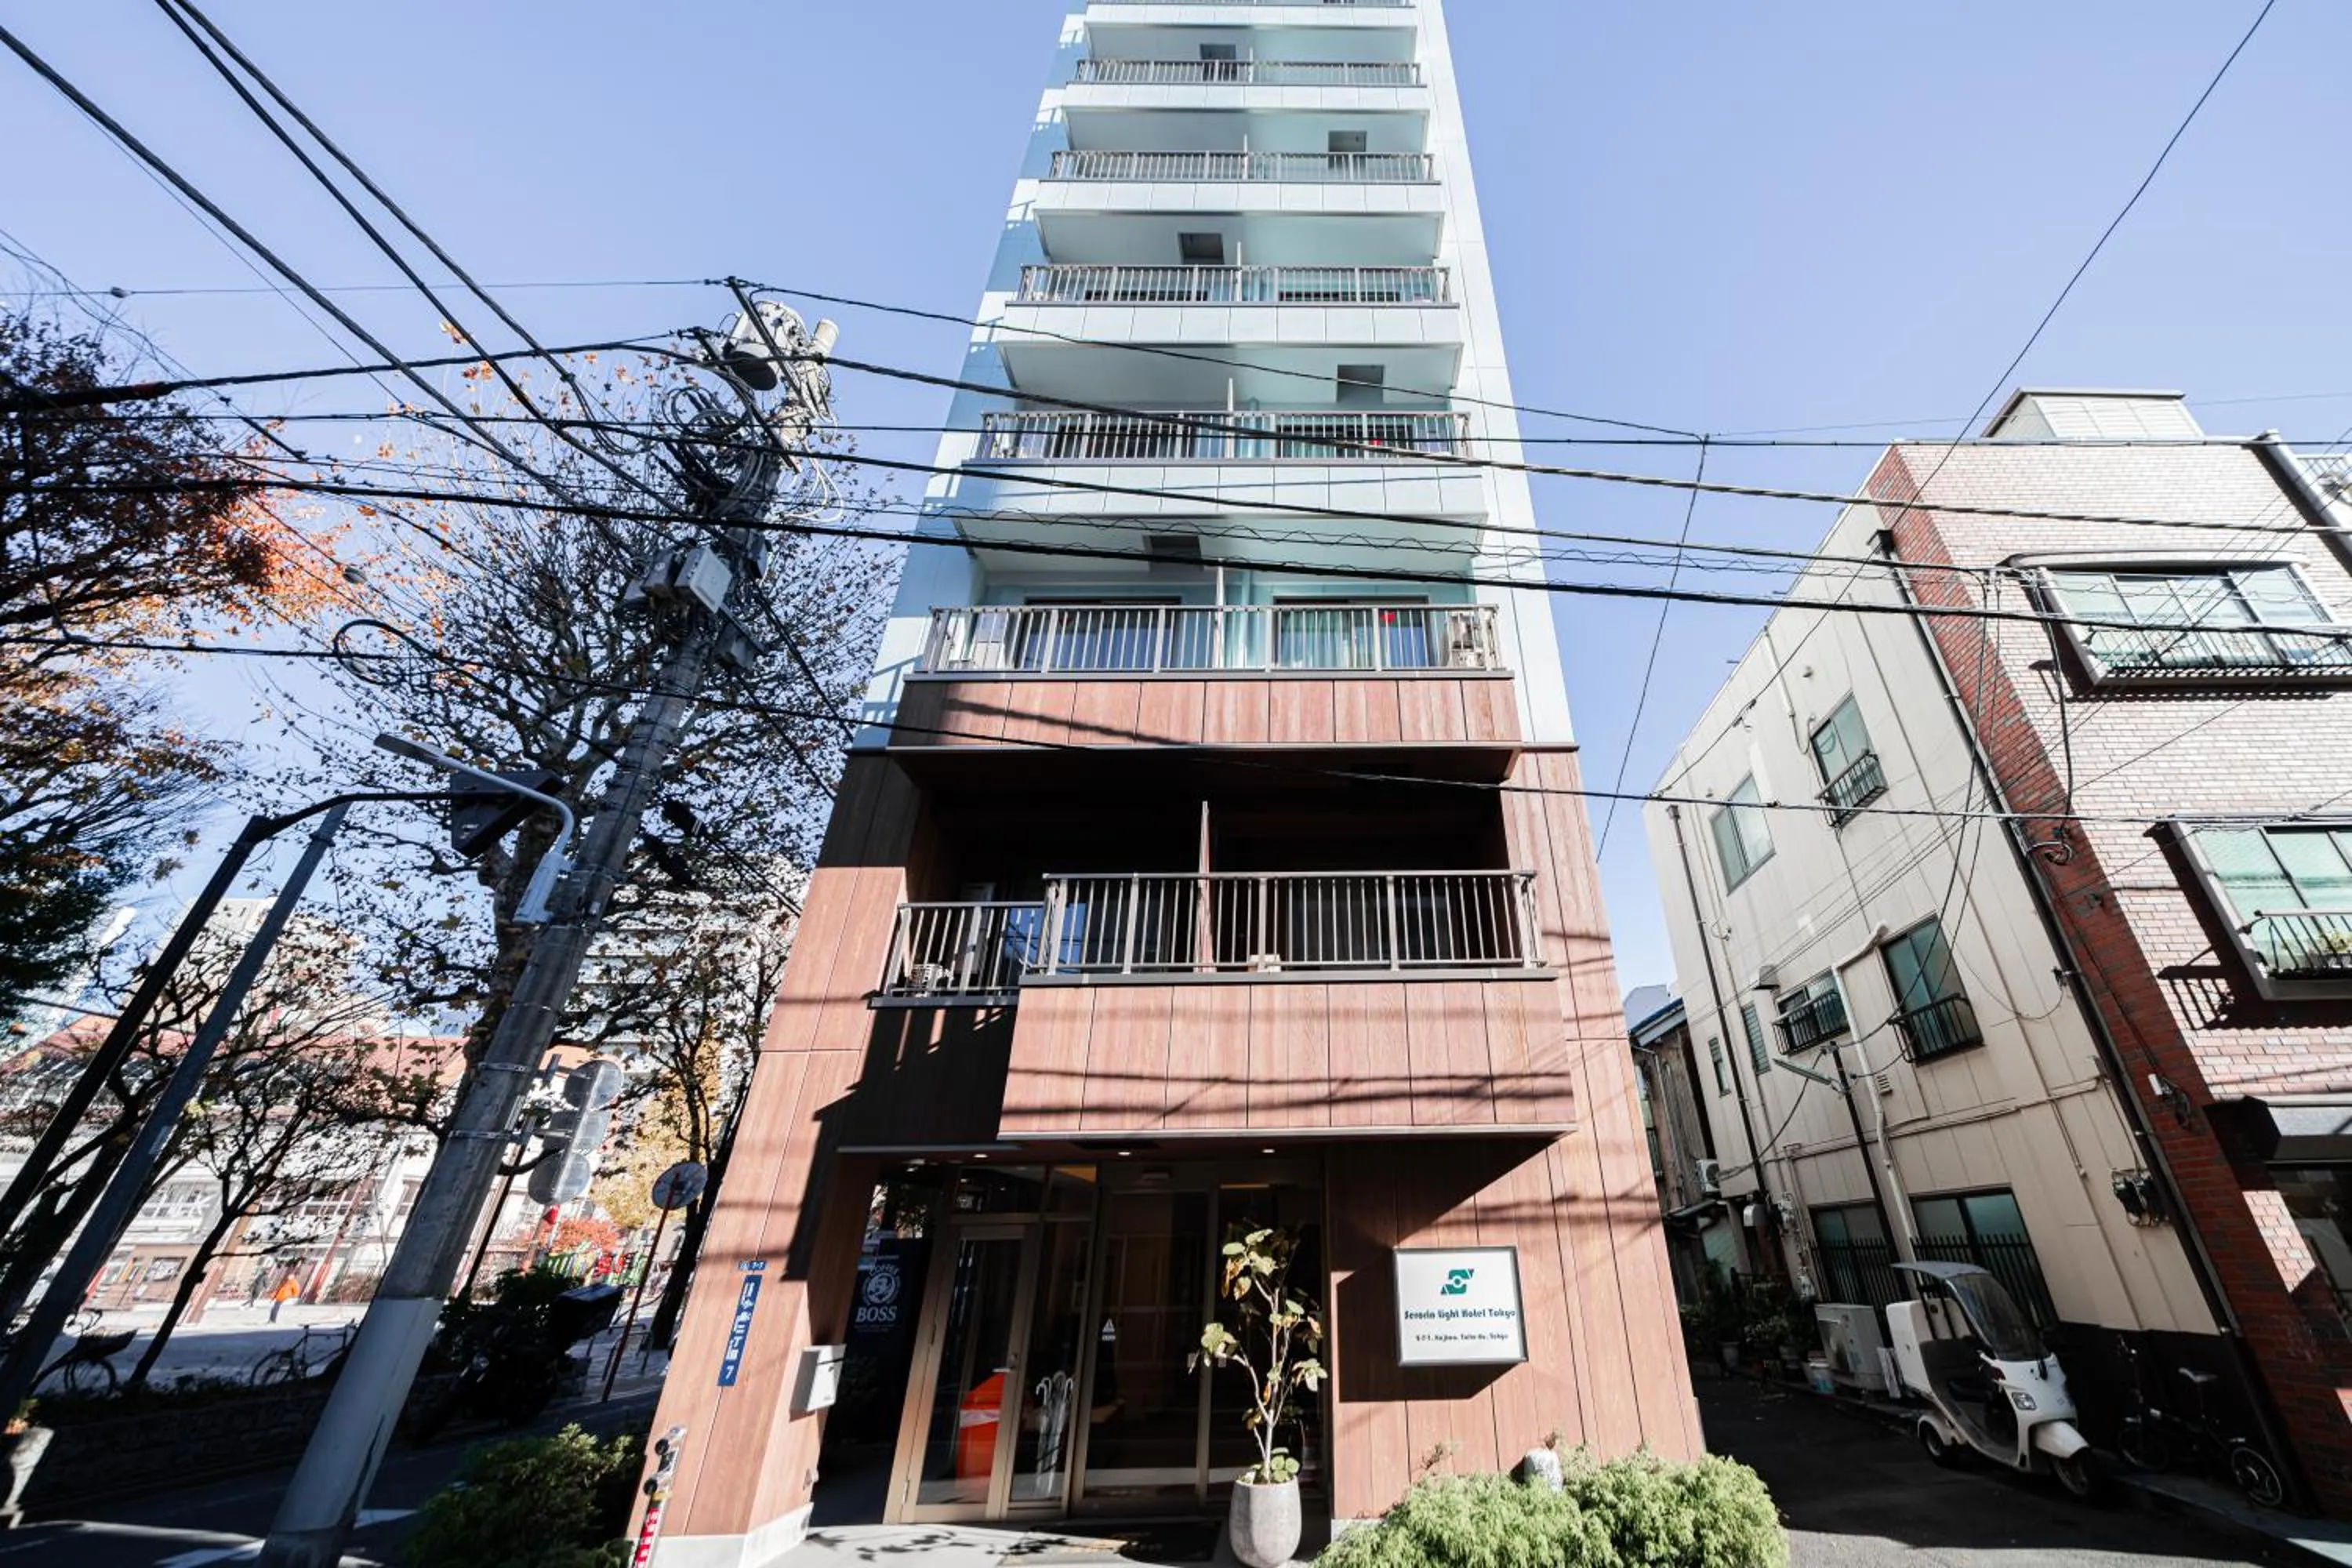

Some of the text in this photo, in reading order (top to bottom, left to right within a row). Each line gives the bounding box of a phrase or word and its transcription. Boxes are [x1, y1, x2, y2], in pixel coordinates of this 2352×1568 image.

[856, 1306, 897, 1323] BOSS
[1488, 1308, 1515, 1319] Tokyo
[726, 1365, 735, 1379] 7
